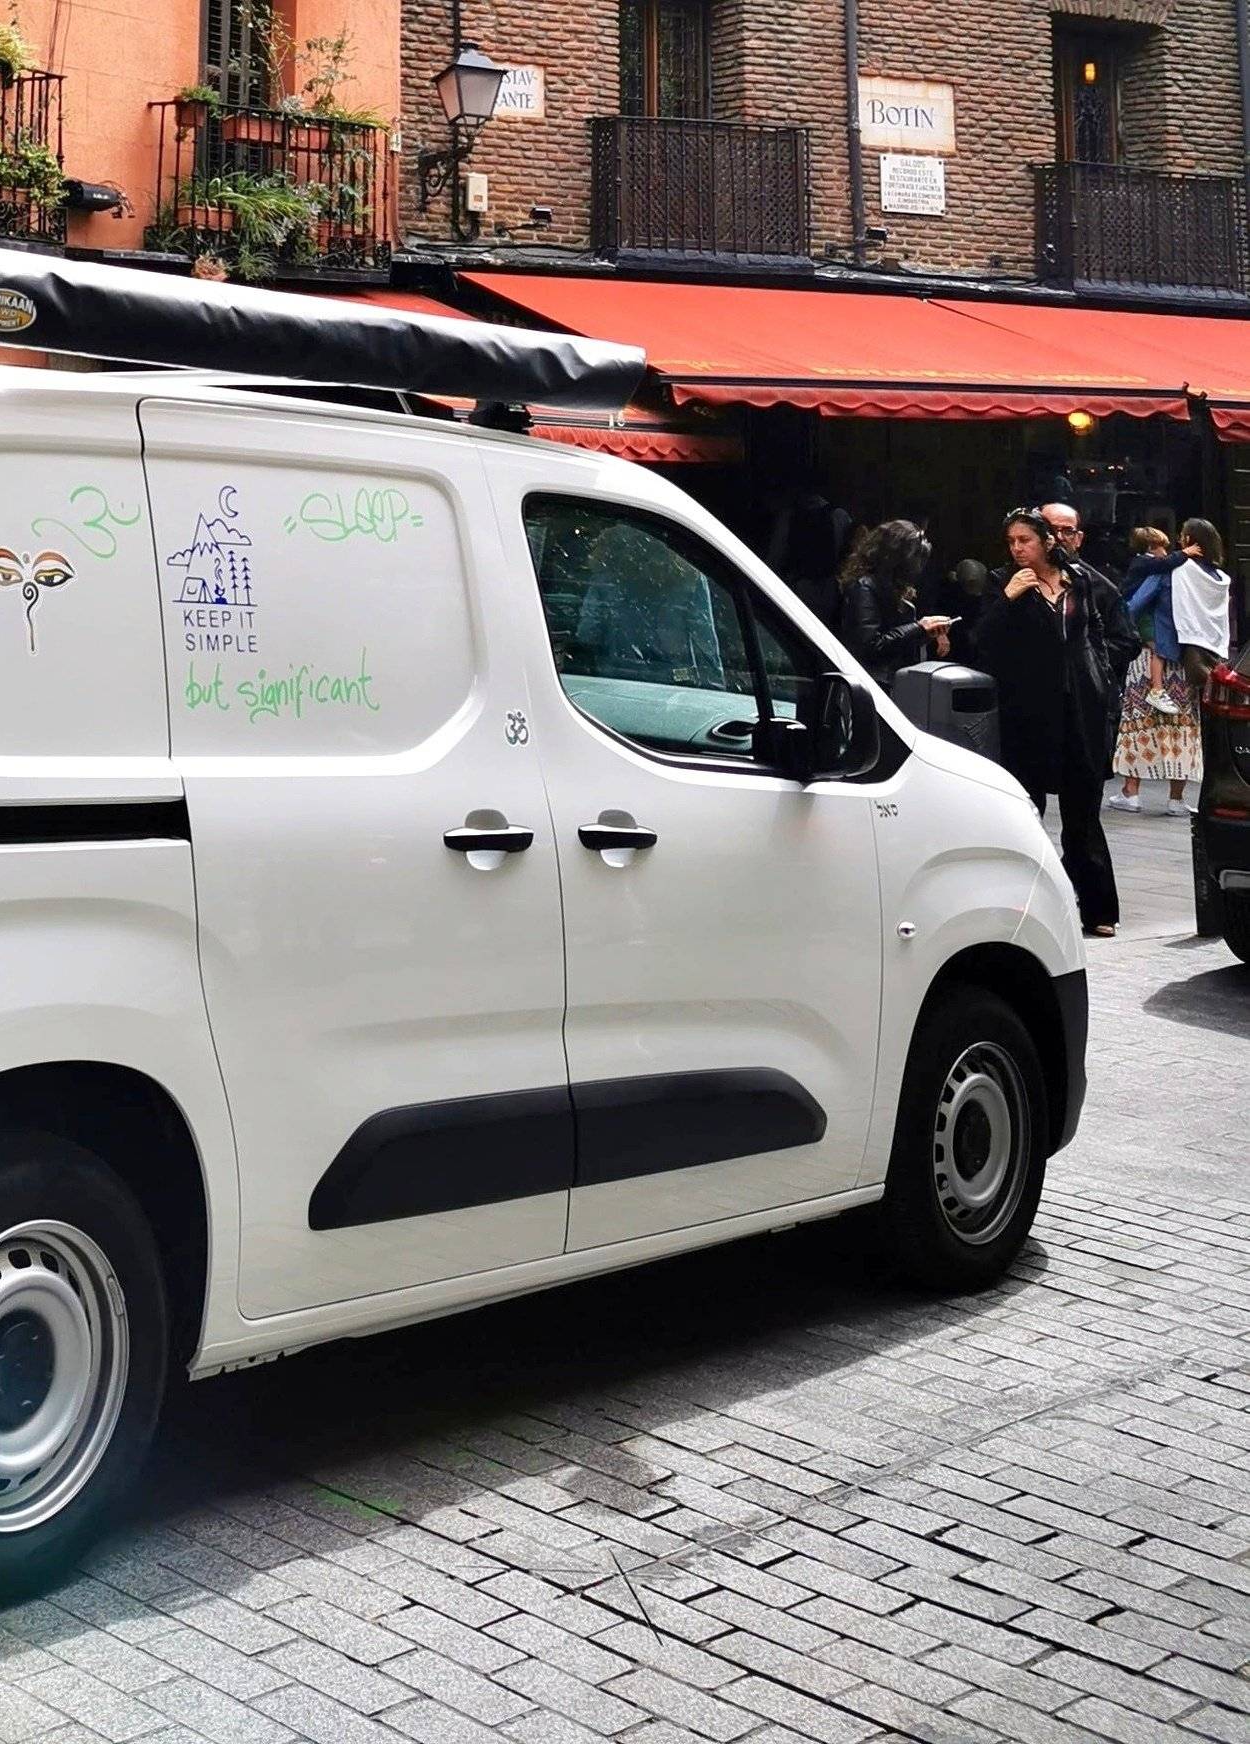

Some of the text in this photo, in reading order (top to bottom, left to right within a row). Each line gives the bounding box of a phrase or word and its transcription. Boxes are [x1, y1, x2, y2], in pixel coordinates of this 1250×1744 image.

[503, 69, 538, 86] STAV-
[496, 91, 535, 109] ANTE
[183, 609, 255, 628] KEEP IT
[184, 633, 258, 653] SIMPLE
[185, 646, 380, 724] but significant
